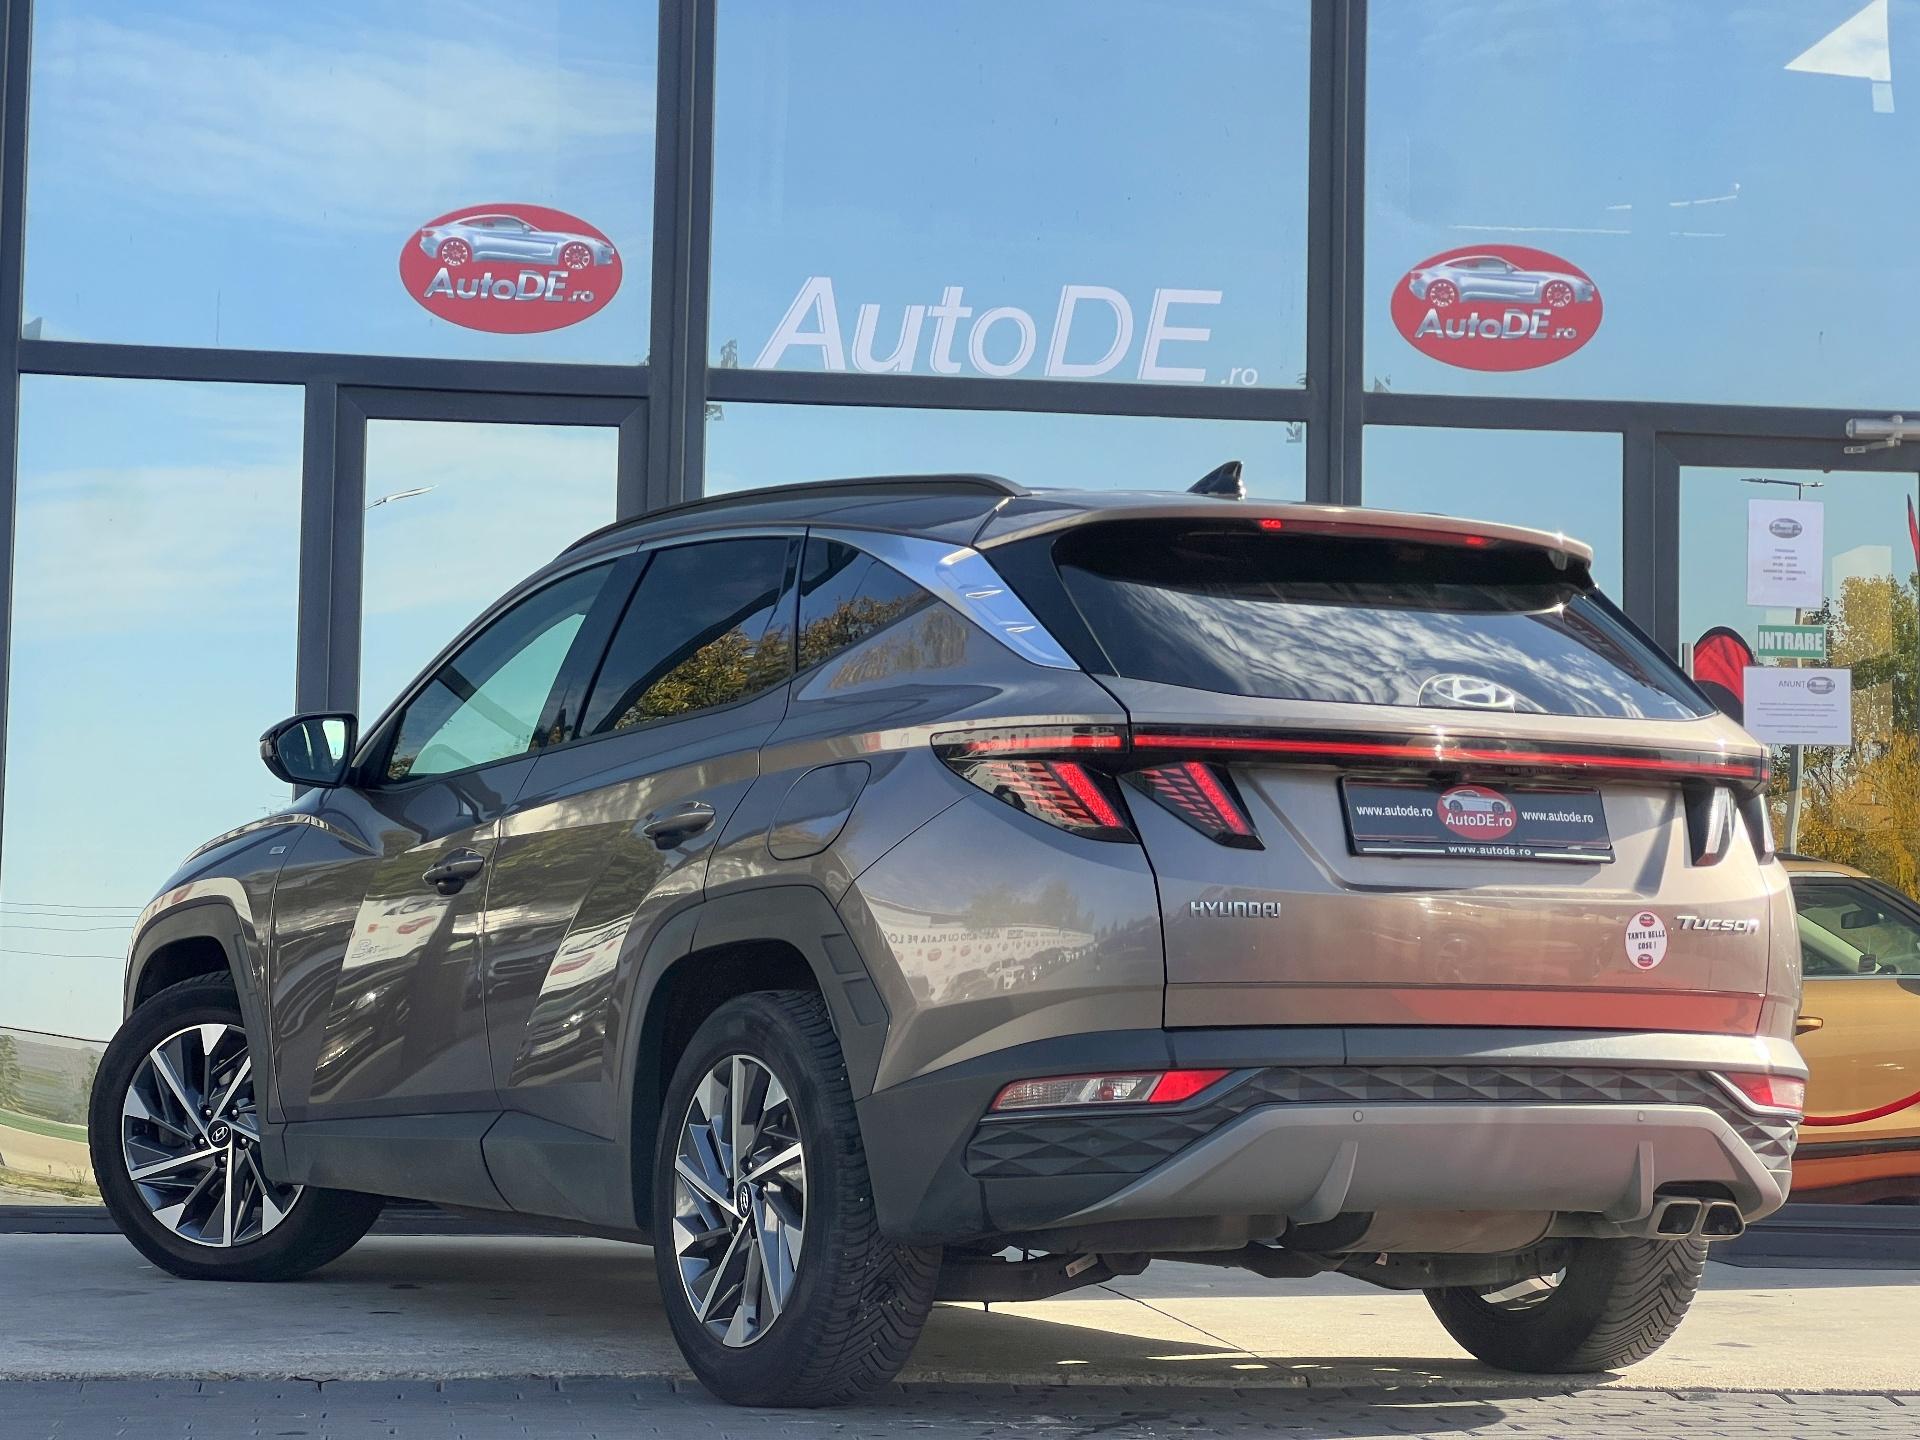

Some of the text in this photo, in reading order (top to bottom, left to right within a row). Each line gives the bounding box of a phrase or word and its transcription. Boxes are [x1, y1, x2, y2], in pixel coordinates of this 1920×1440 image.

[1758, 631, 1823, 650] INTRARE
[1356, 805, 1433, 817] www.autode.ro
[1521, 810, 1594, 823] www.autode.ro
[1445, 812, 1513, 828] AutoDE.ro
[1448, 845, 1531, 856] www.autode.ro
[1190, 901, 1281, 918] HYUNDAI
[1628, 929, 1666, 941] TANTE BELLE
[1637, 942, 1653, 951] COSE
